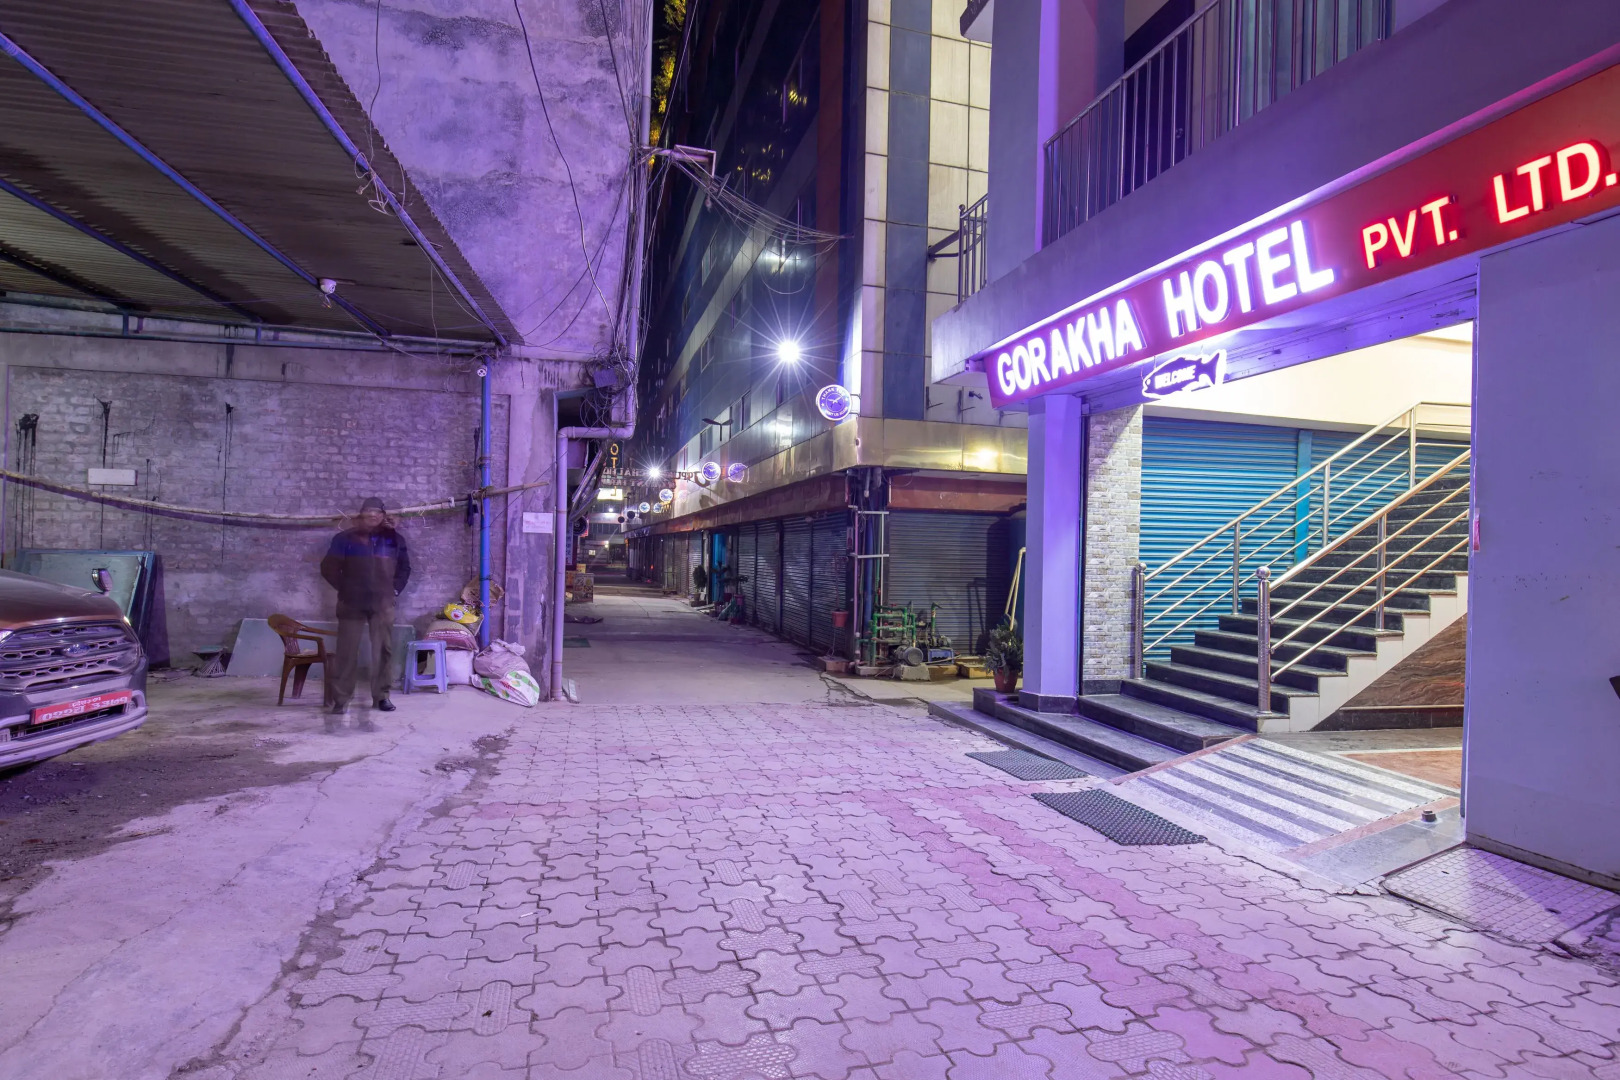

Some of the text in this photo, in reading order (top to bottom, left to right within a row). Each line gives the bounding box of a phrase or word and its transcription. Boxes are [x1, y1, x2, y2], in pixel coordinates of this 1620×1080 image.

[997, 142, 1617, 396] GORAKHA HOTEL PVT. LTD.
[821, 387, 835, 400] THANK
